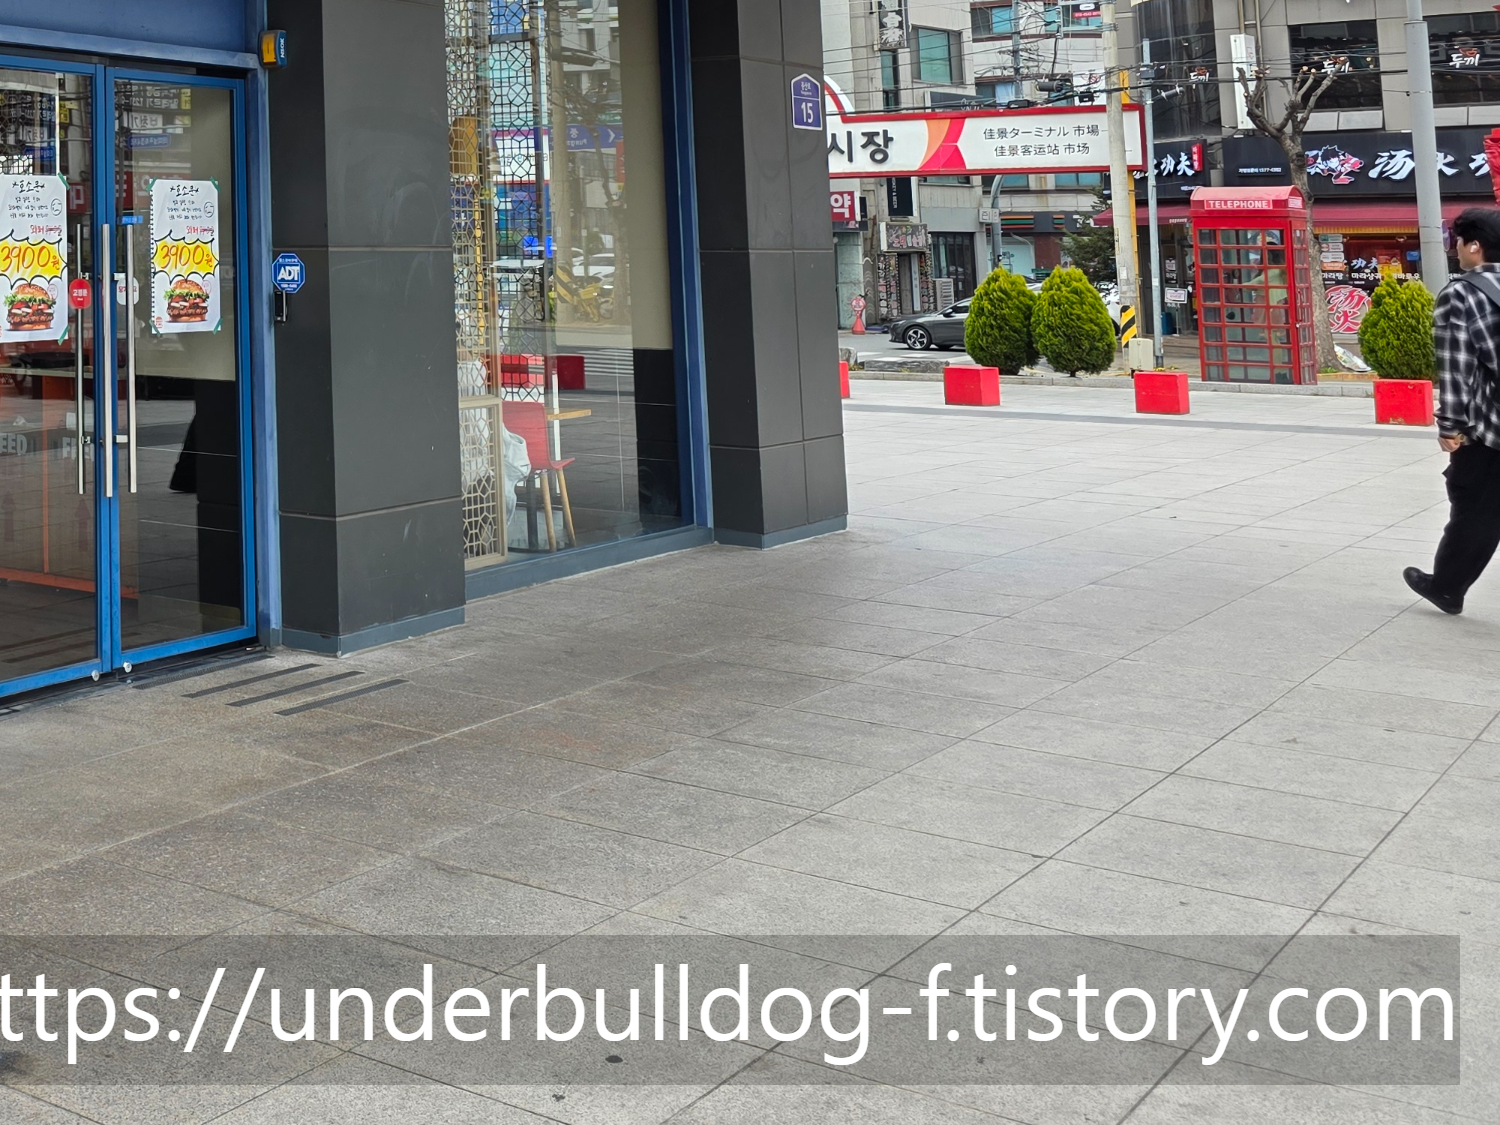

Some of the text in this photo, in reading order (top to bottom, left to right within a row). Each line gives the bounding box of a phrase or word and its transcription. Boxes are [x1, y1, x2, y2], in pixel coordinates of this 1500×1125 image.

[801, 102, 814, 124] 15
[983, 124, 1100, 140] 佳景ターミナル 市場
[828, 129, 894, 164] 시장
[994, 142, 1090, 157] 佳景客运站 市场
[830, 193, 851, 219] 약
[1208, 200, 1269, 209] TELEPHONE
[0, 245, 61, 273] 3900원
[160, 244, 213, 270] 3900원
[278, 266, 300, 281] ADT
